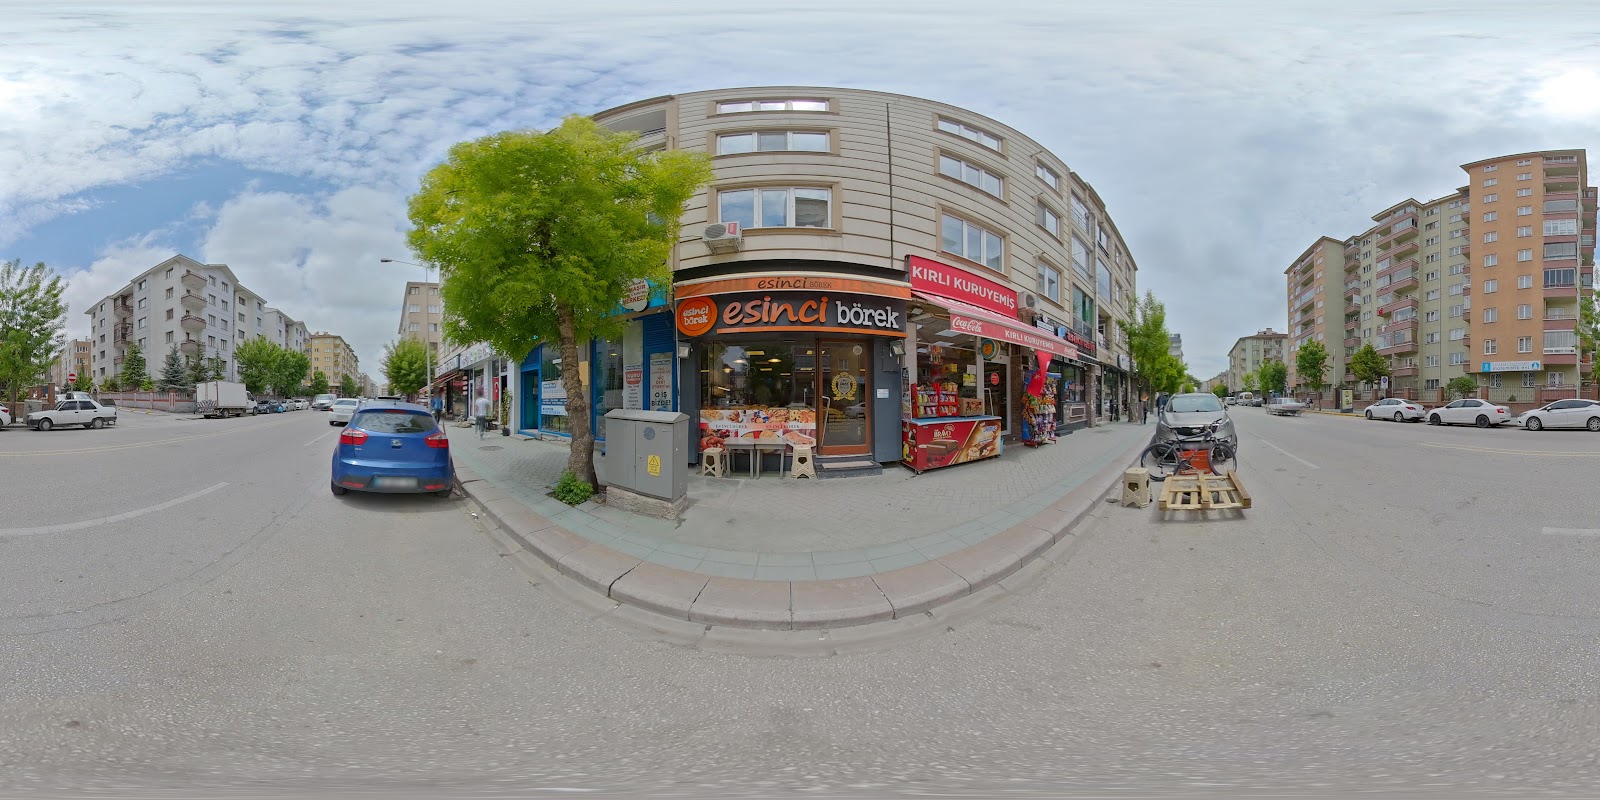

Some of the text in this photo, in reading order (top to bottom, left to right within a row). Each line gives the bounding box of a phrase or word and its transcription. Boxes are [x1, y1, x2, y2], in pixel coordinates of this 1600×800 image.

[758, 277, 832, 289] esinci BÖREK
[912, 265, 1015, 310] KIRLI KURUYEMİŞ
[683, 305, 709, 317] esinci
[723, 295, 899, 329] esinci börek
[684, 314, 709, 326] börek
[1005, 330, 1023, 342] KIRLI
[1023, 334, 1054, 350] KURUYEMİŞ
